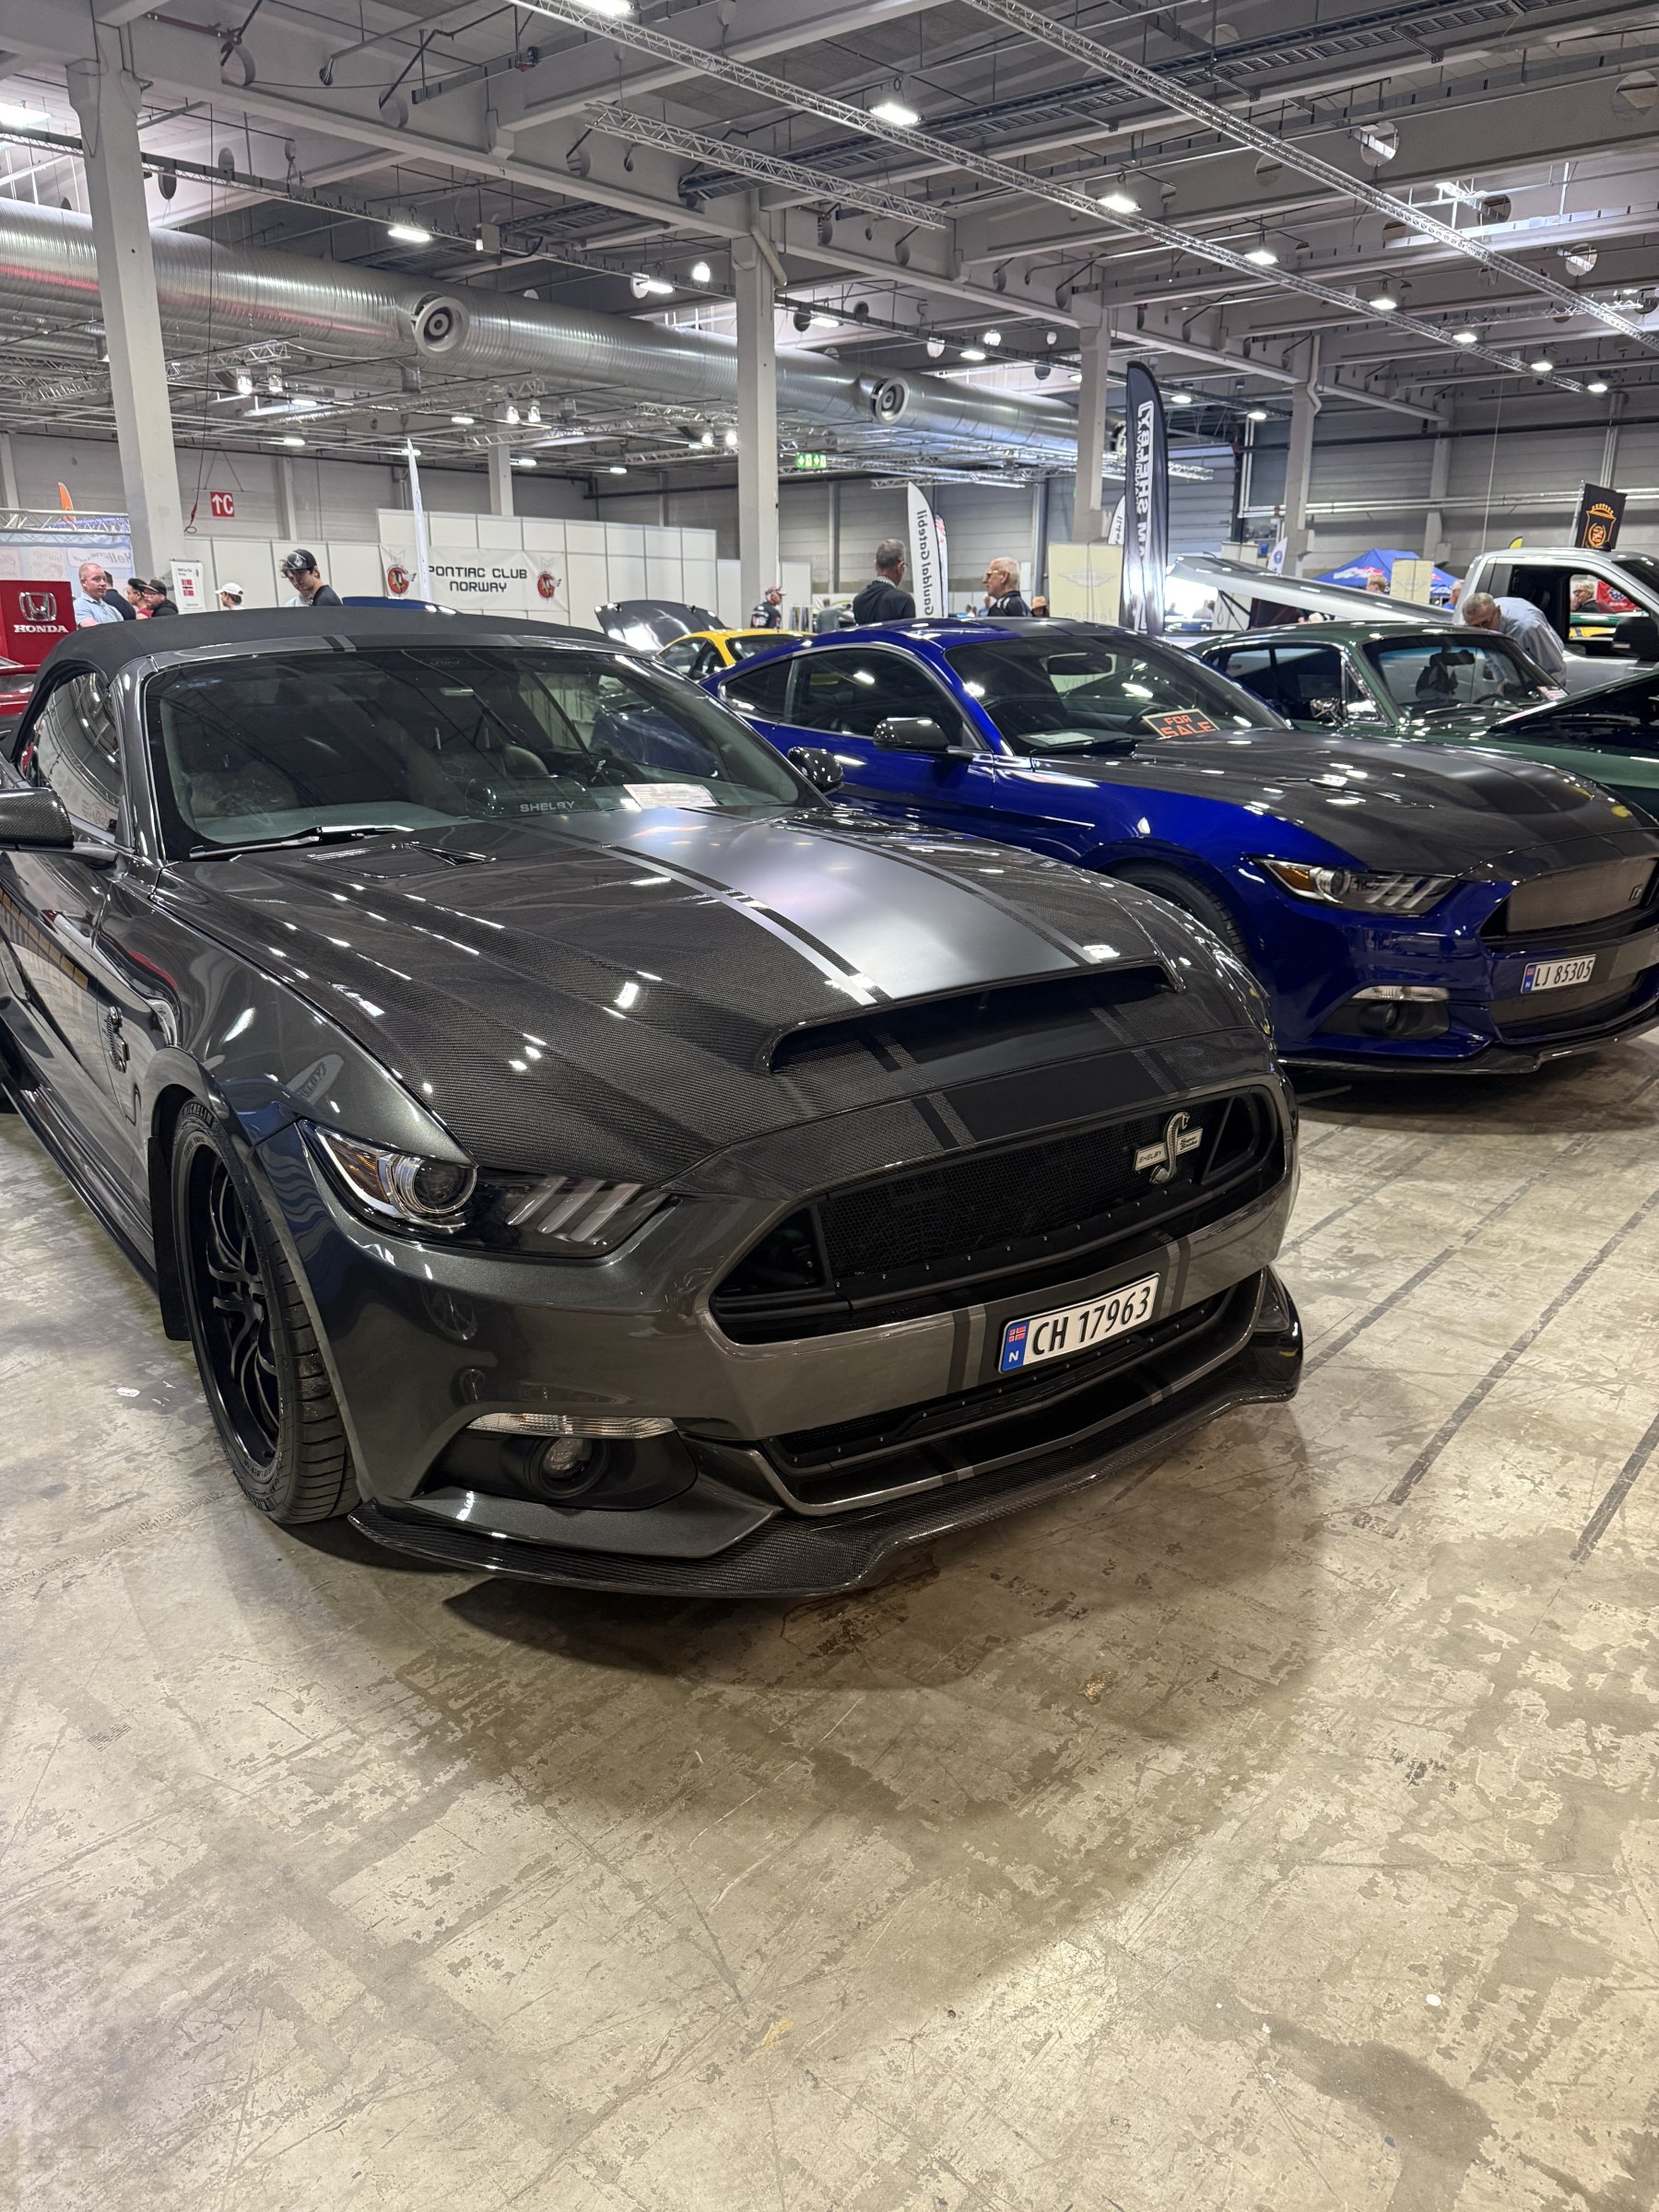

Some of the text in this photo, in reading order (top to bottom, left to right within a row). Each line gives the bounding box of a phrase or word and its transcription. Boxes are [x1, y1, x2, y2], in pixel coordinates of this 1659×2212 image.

[223, 494, 234, 514] C
[429, 565, 527, 579] PONTIAC CLUB
[450, 581, 507, 593] NORWAY
[14, 625, 69, 633] HONDA
[1163, 714, 1193, 725] FOR
[1160, 722, 1217, 737] SALE
[520, 801, 575, 812] SHELBY
[1535, 959, 1594, 987] LJ 85305
[1032, 1287, 1151, 1356] CH 17963
[1008, 1351, 1018, 1362] N
